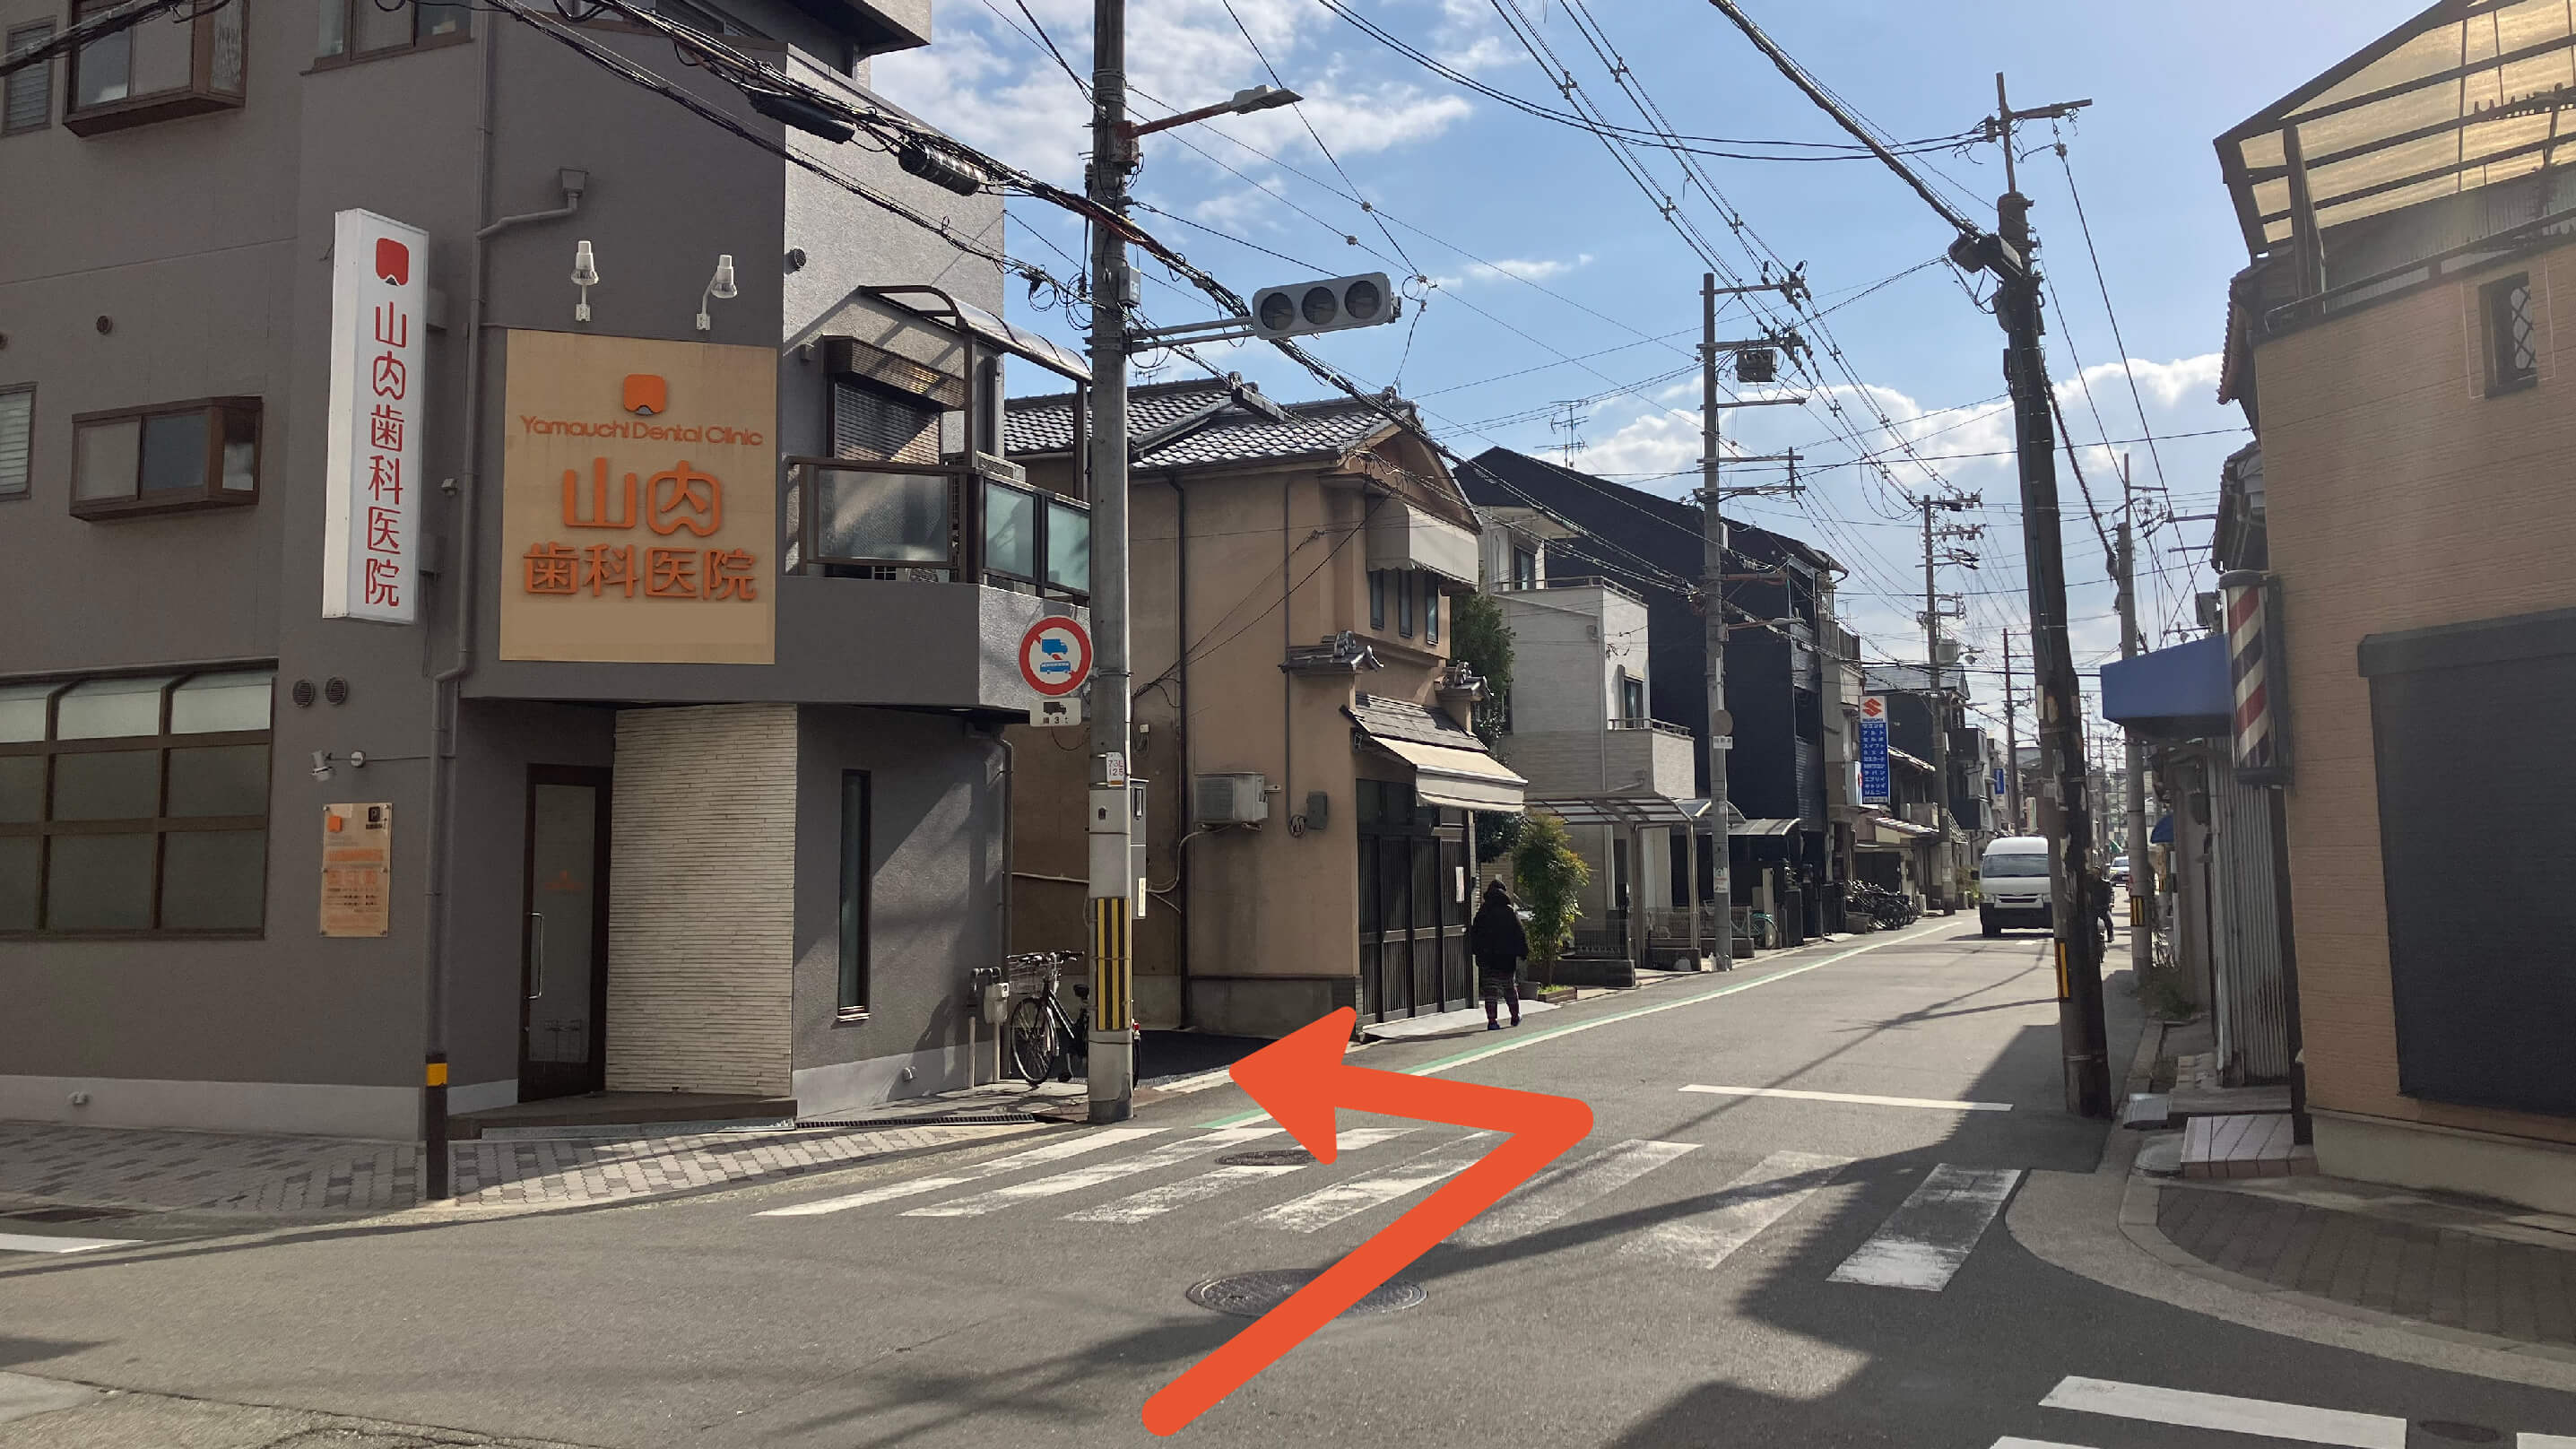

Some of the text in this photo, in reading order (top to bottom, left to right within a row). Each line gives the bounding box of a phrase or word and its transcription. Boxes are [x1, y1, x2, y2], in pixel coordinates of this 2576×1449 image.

[364, 300, 407, 608] 山内歯科医院
[520, 414, 763, 447] Yamauchi Dental Clinic
[562, 456, 722, 537] 山内
[523, 541, 758, 602] 歯科医院
